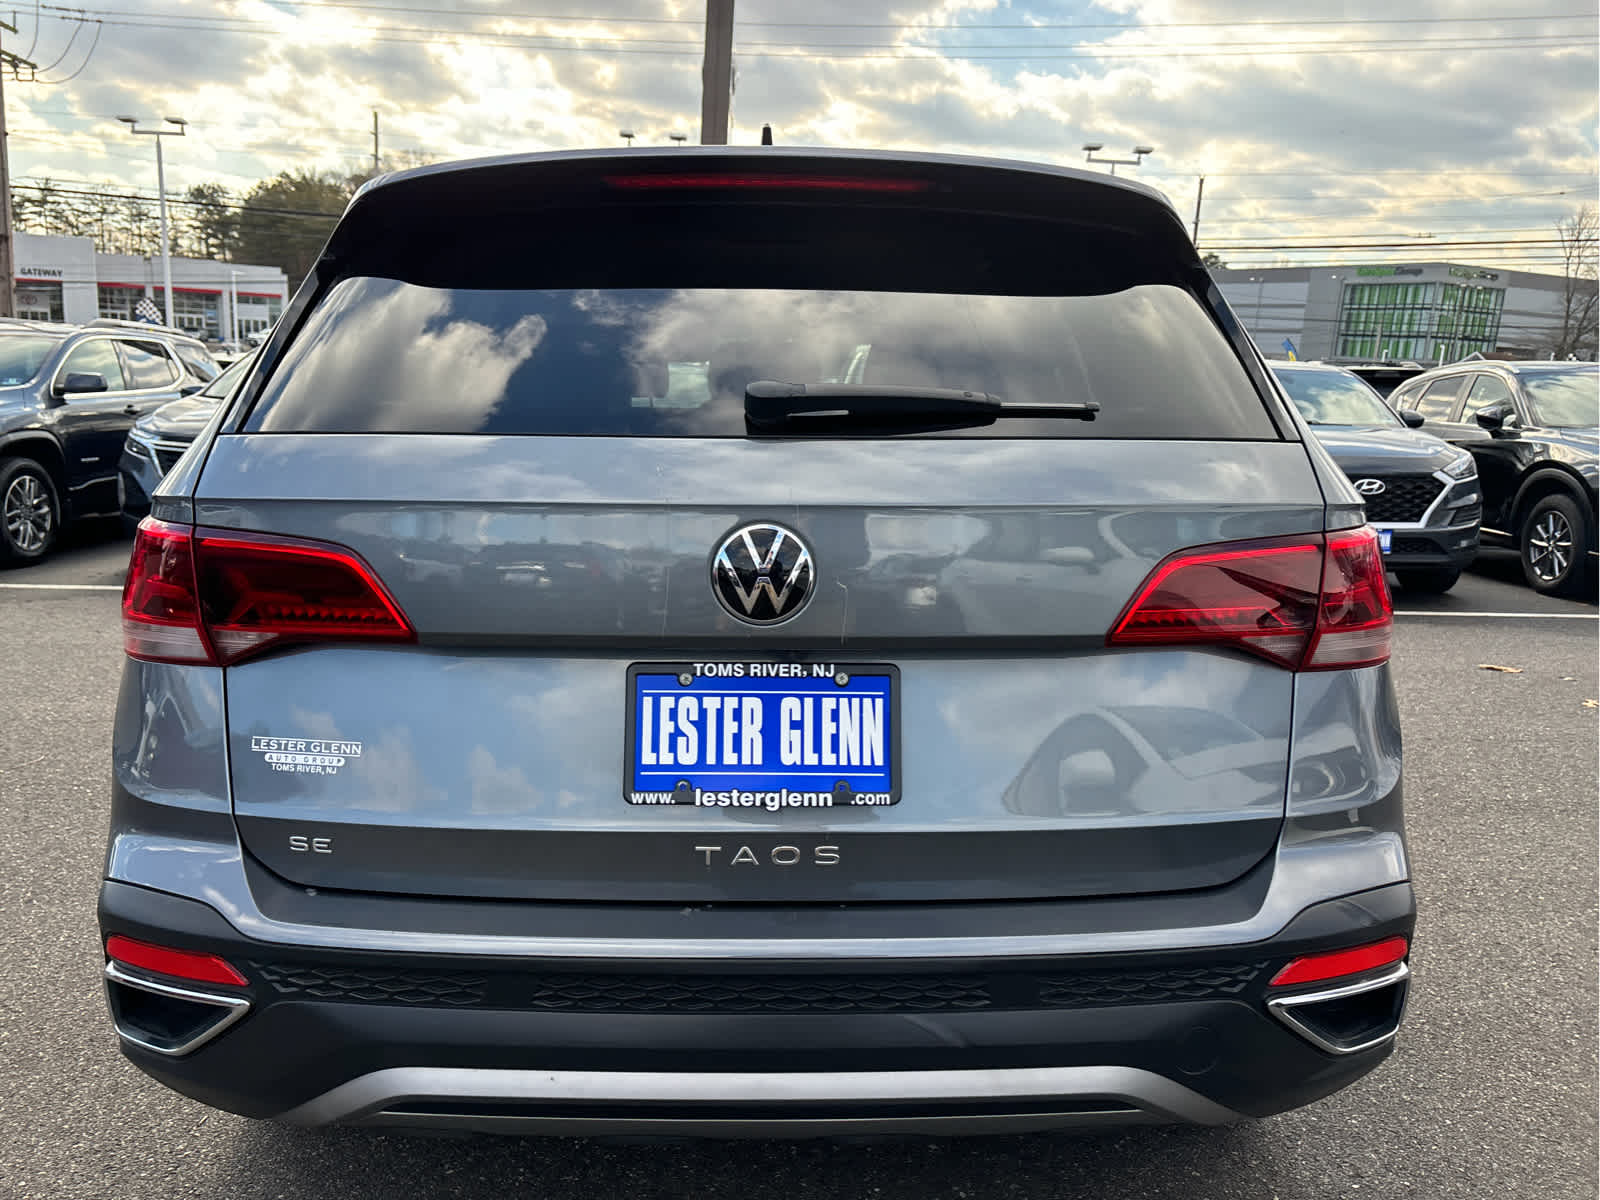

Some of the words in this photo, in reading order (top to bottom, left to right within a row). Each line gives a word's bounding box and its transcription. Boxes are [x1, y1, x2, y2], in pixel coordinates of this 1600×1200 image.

[20, 267, 63, 277] GATEWAY
[693, 663, 745, 677] TOMS
[750, 663, 808, 678] RIVER,
[812, 664, 836, 678] NJ
[641, 696, 764, 766] LESTER
[780, 696, 884, 766] GLENN
[251, 738, 306, 752] LESTER
[310, 742, 362, 755] GLENN
[268, 754, 297, 763] AUTO
[303, 755, 342, 765] GROUP
[271, 763, 295, 773] TOMS
[296, 764, 325, 775] RIVER,
[326, 767, 337, 775] NJ
[631, 792, 676, 805] www.
[695, 788, 833, 811] lesterglenn
[850, 792, 891, 805] .com
[289, 836, 333, 853] SE
[695, 845, 841, 866] TAOS
